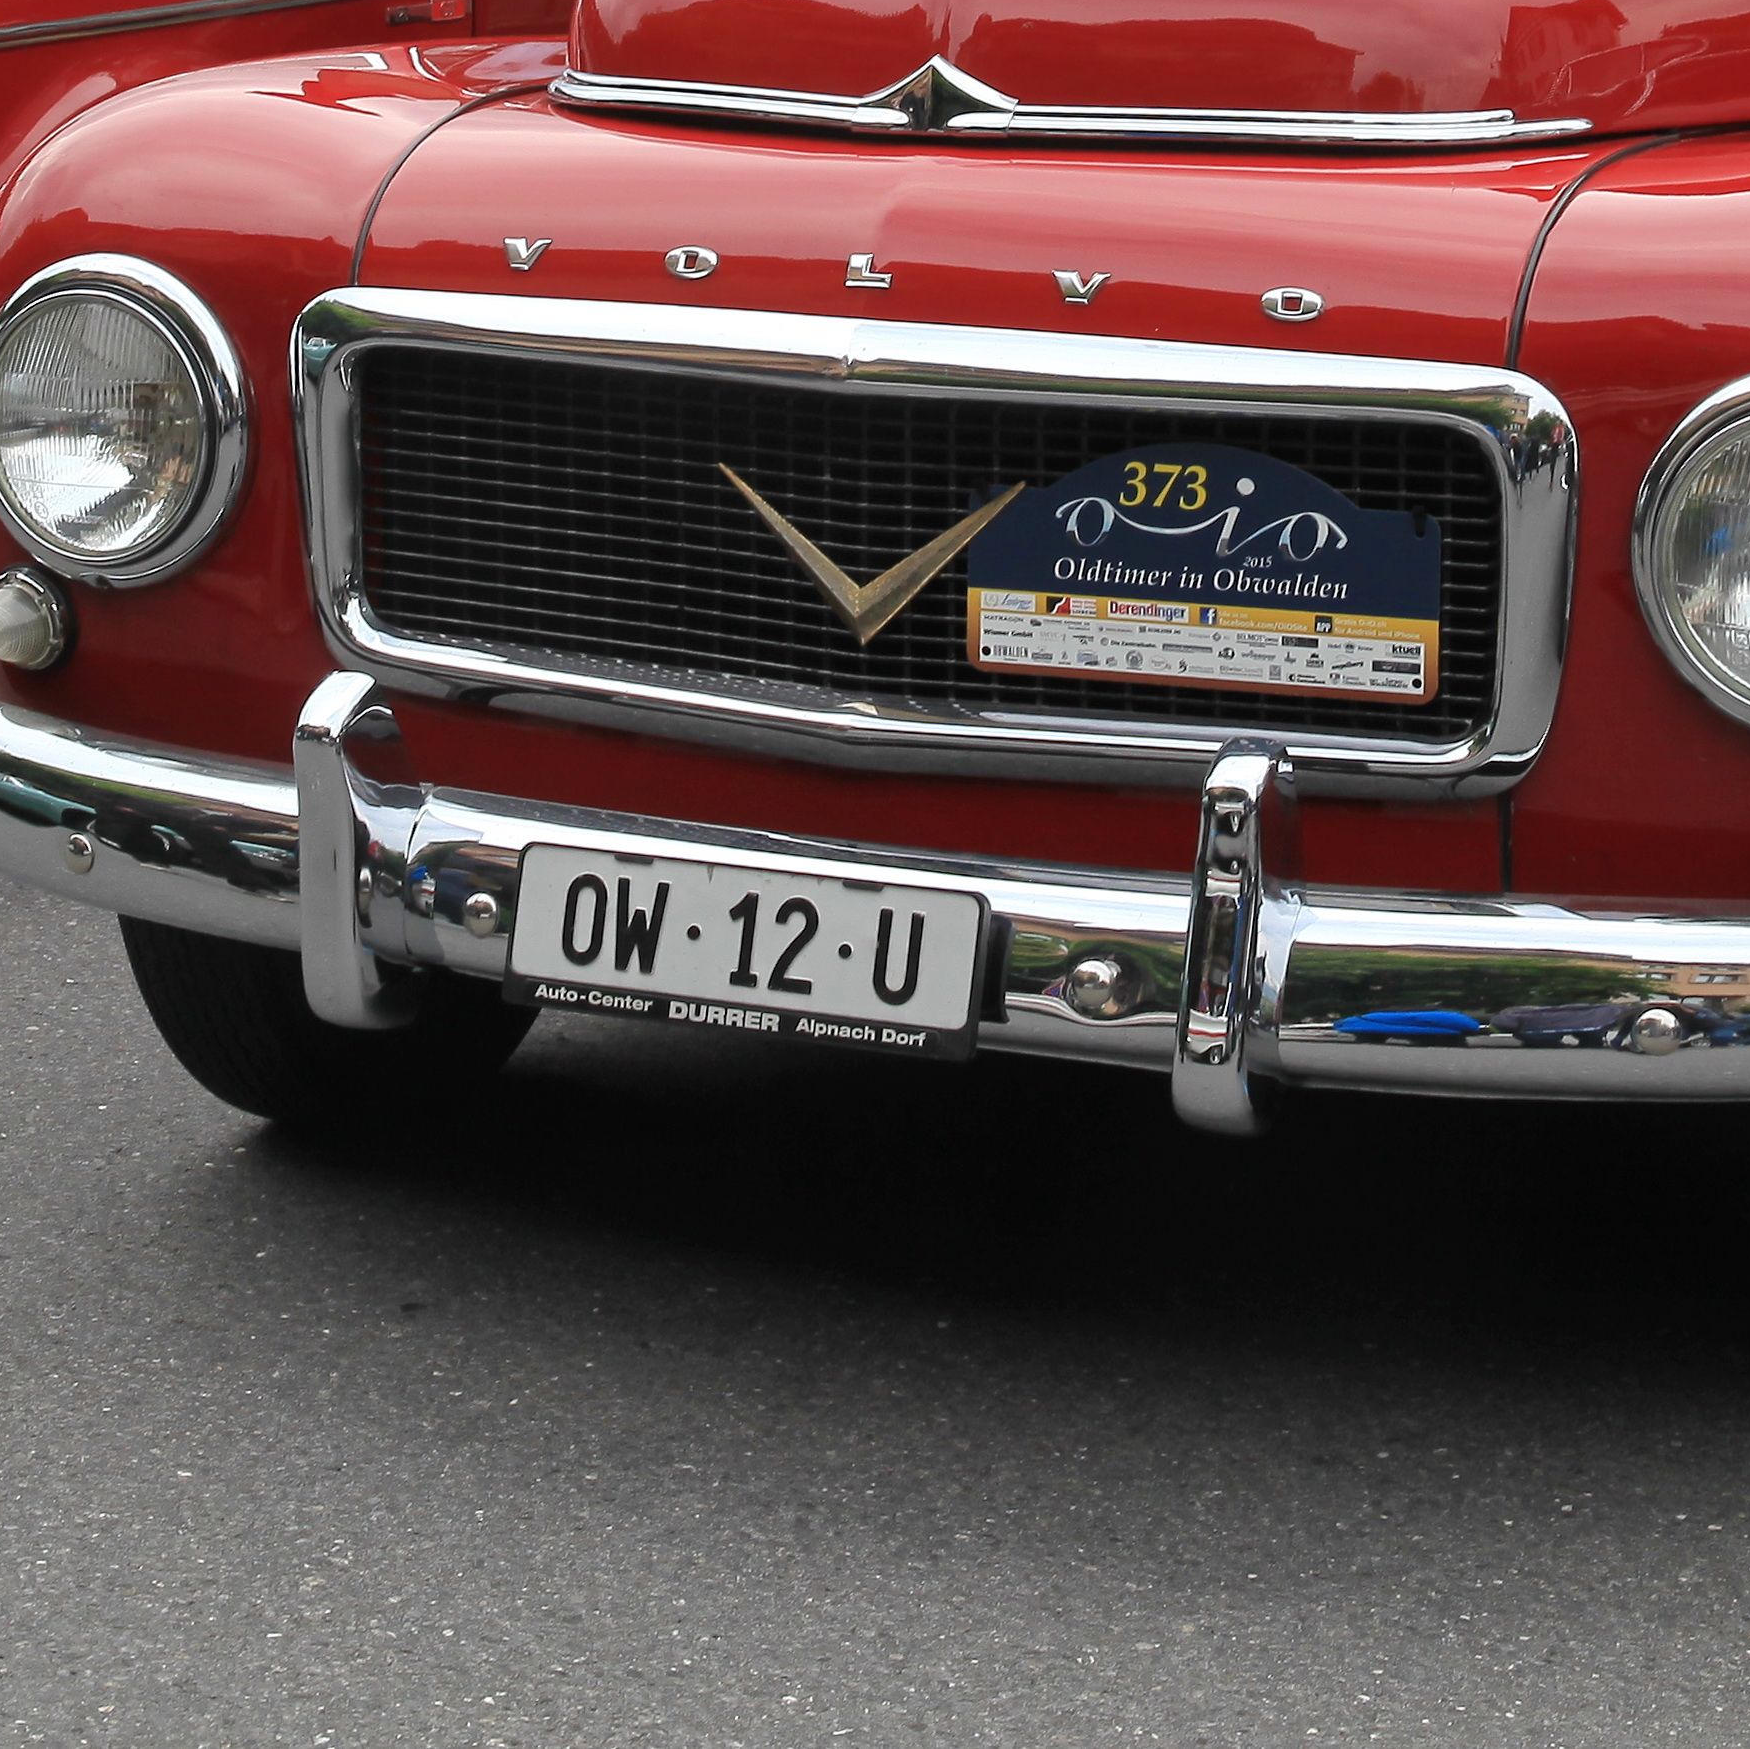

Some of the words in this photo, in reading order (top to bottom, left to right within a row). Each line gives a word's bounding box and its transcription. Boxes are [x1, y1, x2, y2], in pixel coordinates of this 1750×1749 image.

[503, 235, 1326, 323] VOLVO
[1119, 460, 1208, 510] 373
[1053, 556, 1172, 588] Oldtimer
[1178, 565, 1205, 590] in
[1213, 567, 1349, 600] Obwalden
[1242, 554, 1273, 569] 2015
[1110, 600, 1186, 622] Derendinger
[534, 983, 653, 1012] Auto-Center
[668, 1000, 780, 1032] DURRER
[795, 1017, 875, 1041] Alpnach
[881, 1027, 926, 1048] Dorf
